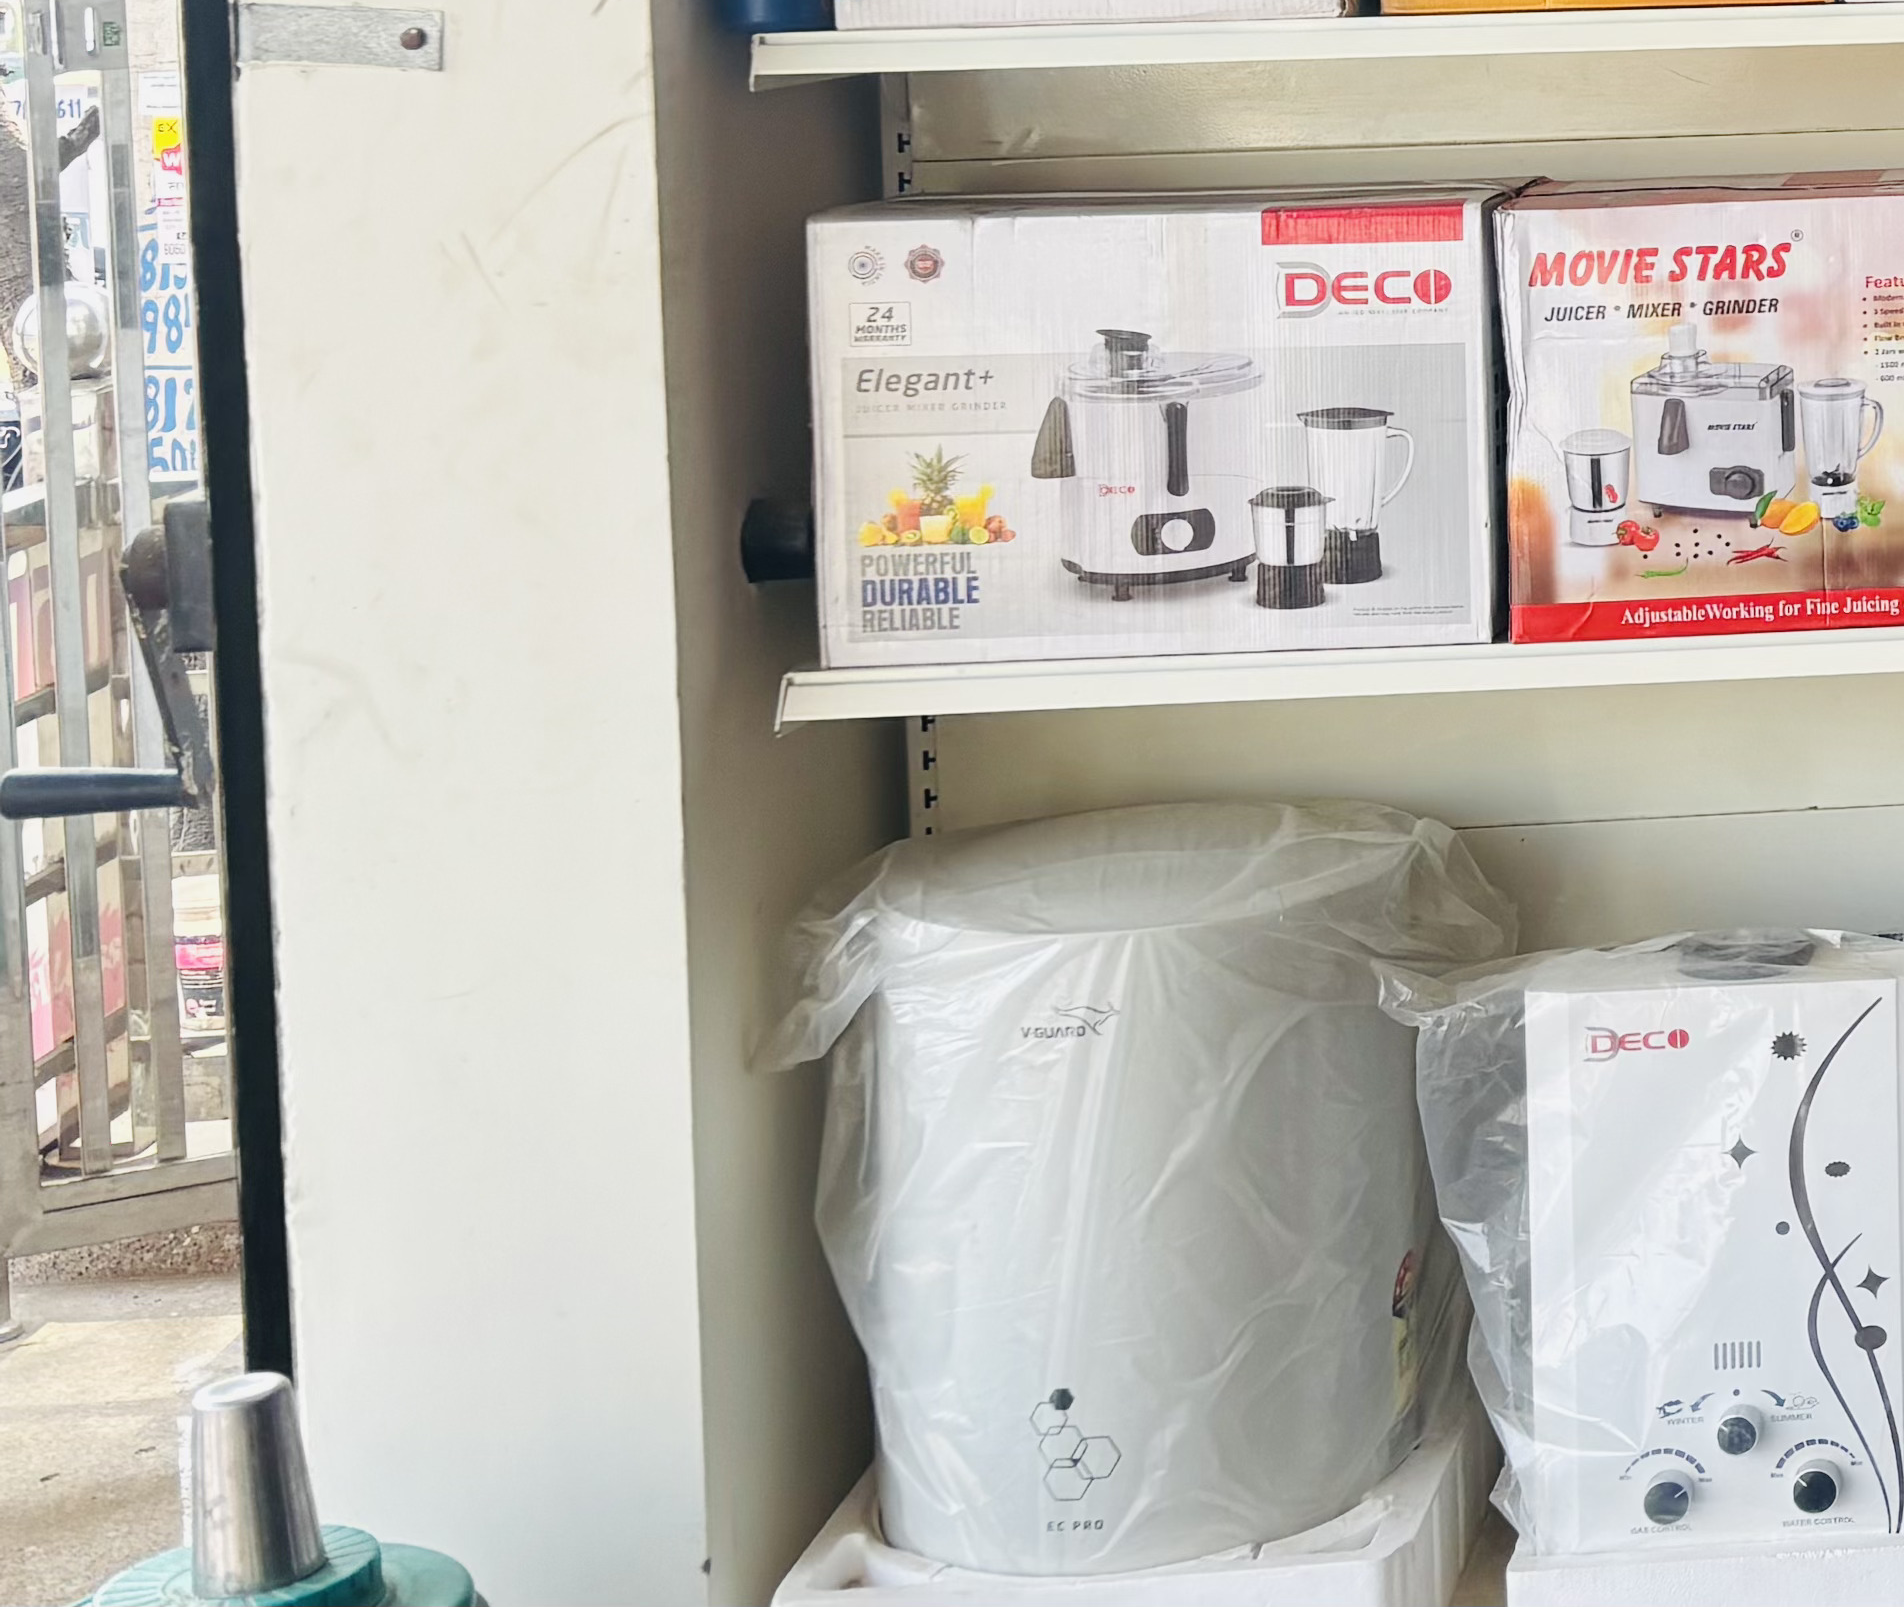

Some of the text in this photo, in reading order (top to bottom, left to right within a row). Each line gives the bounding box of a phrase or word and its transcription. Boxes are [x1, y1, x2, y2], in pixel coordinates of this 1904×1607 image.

[1529, 243, 1790, 287] MOVIE STARS
[856, 368, 995, 397] Elegant+
[861, 553, 976, 576] POWERFUL
[861, 577, 979, 606] DURABLE
[862, 607, 960, 632] RELIABLE
[1778, 600, 1800, 617] for
[1806, 598, 1838, 617] Fine
[1843, 595, 1899, 616] Juicing
